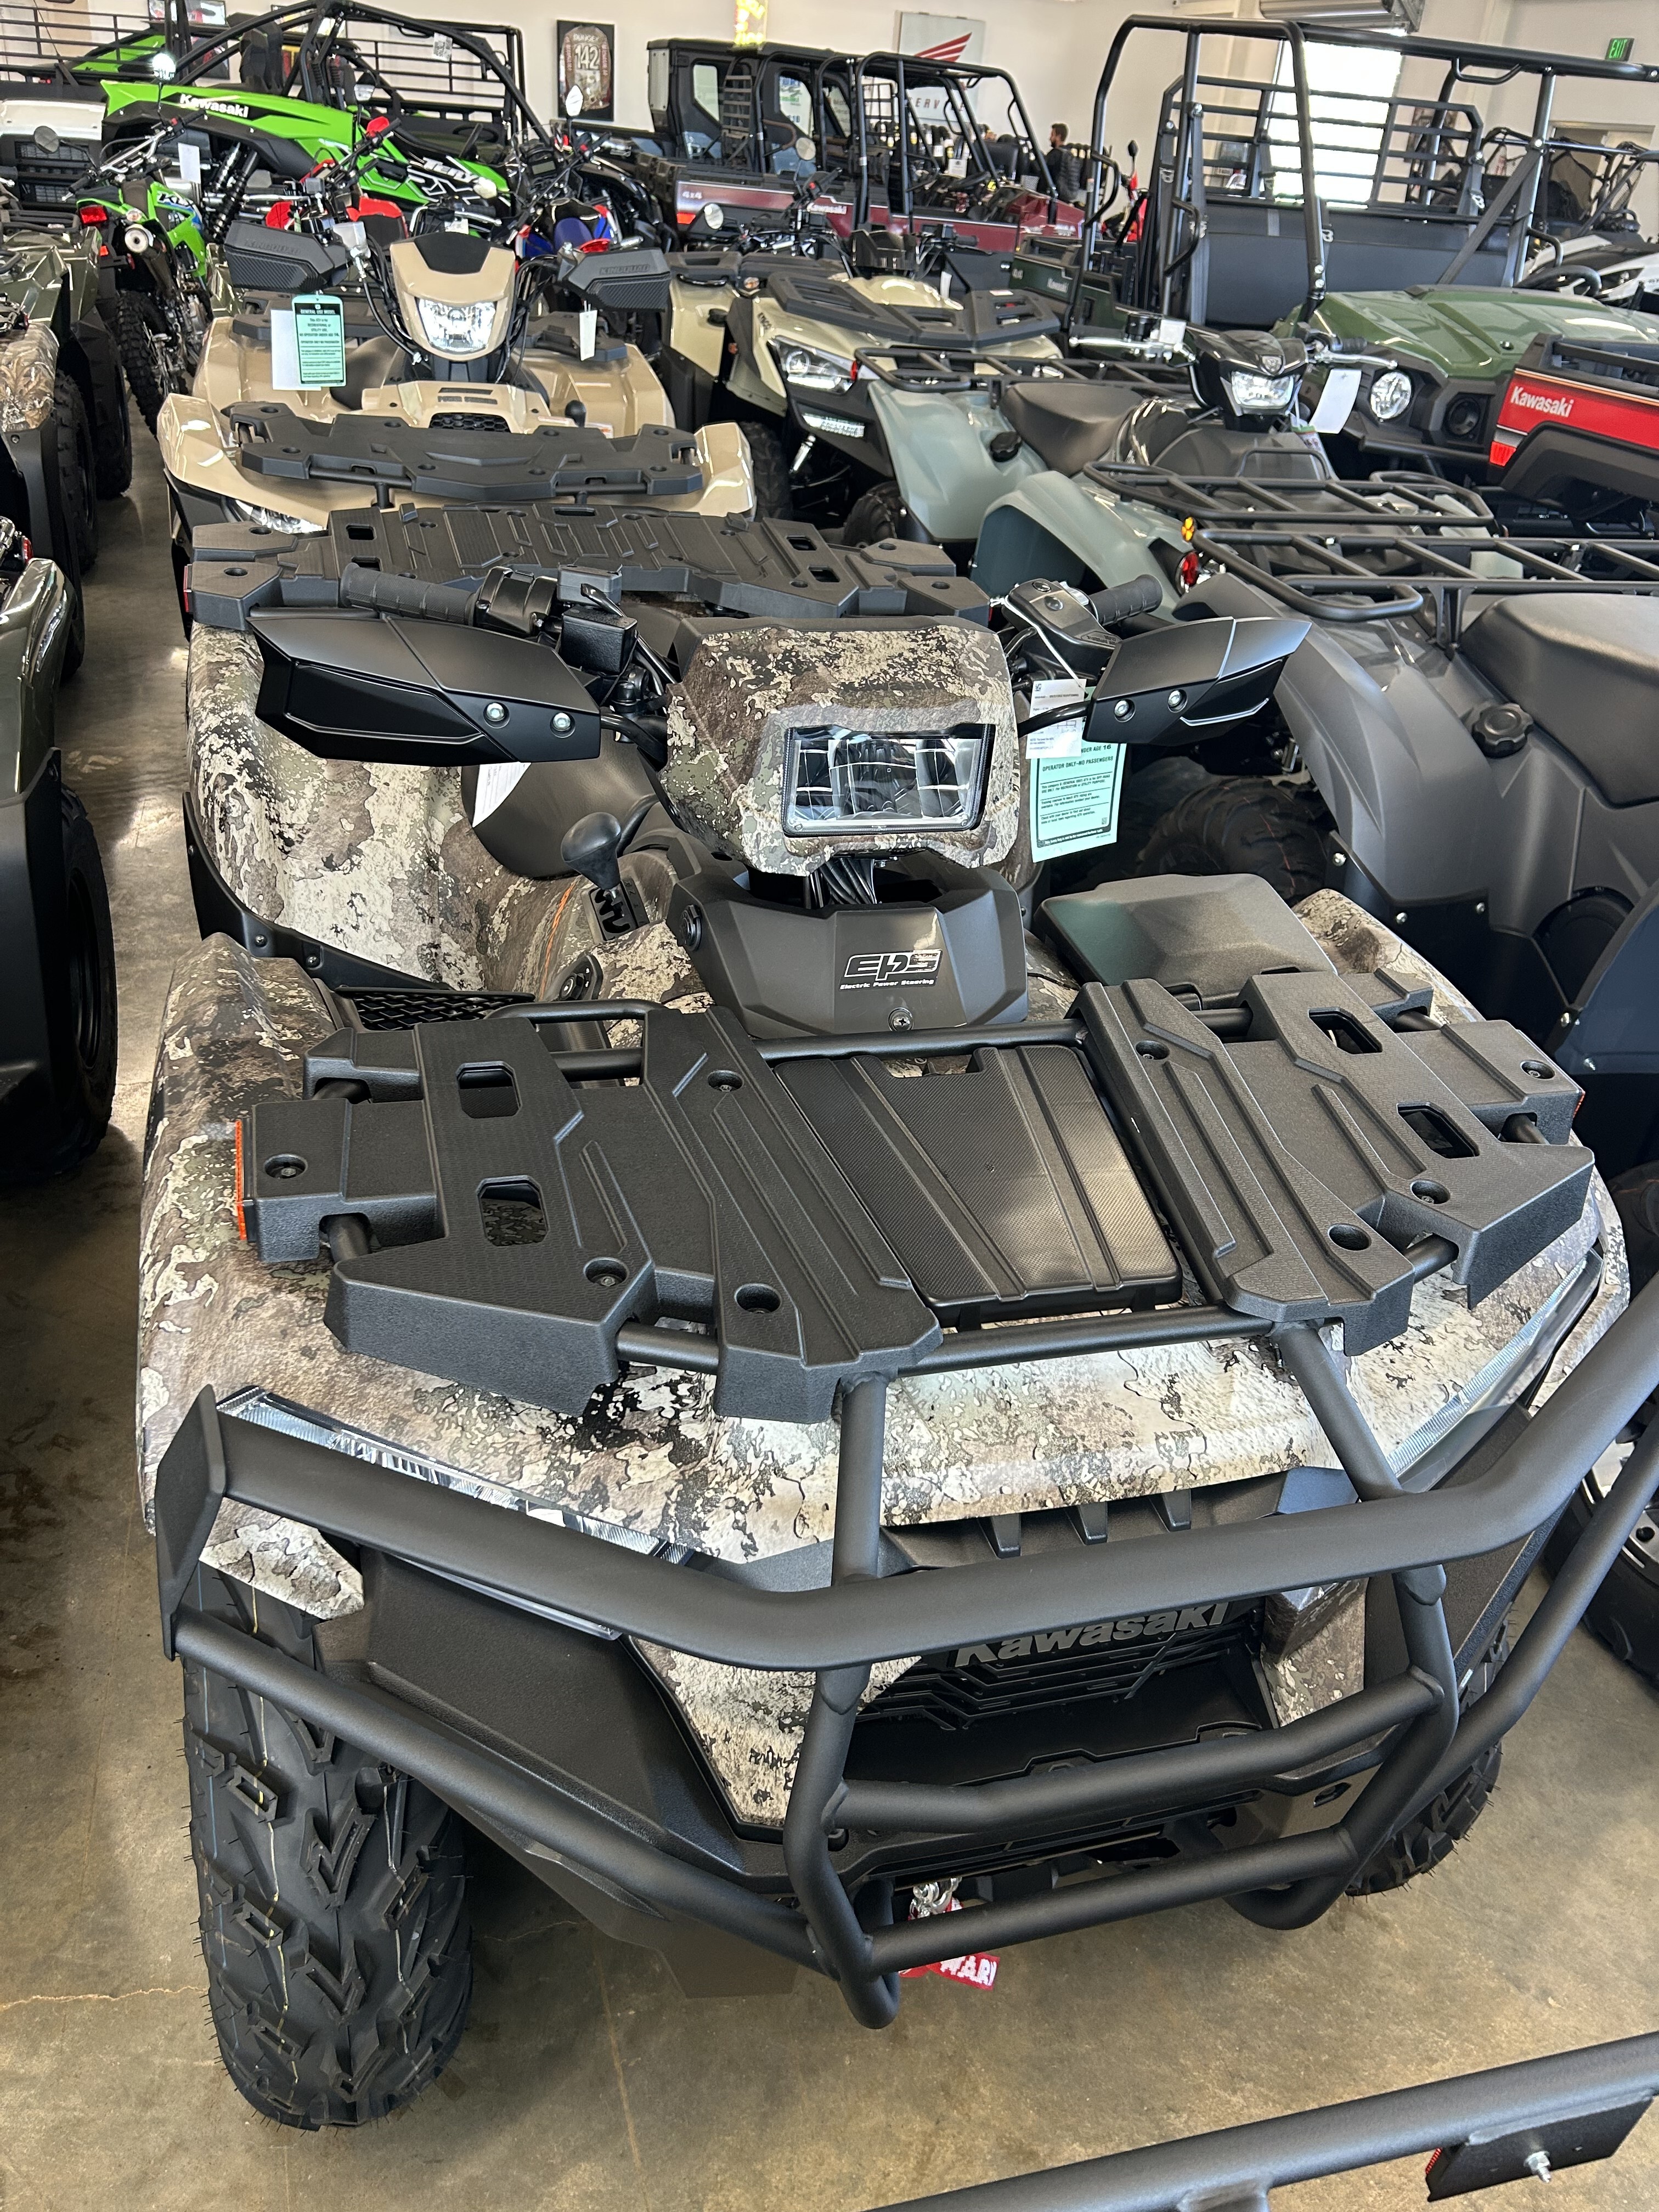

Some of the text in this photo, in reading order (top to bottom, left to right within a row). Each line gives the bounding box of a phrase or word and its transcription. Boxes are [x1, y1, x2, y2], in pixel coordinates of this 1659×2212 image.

[575, 44, 599, 70] 142
[1609, 39, 1628, 58] EXIT
[180, 94, 249, 117] Kawasaki
[1510, 386, 1574, 417] Kawasaki
[1086, 756, 1113, 764] PASSENGERS
[844, 949, 943, 981] EPS
[955, 1602, 1228, 1668] Kawasaki
